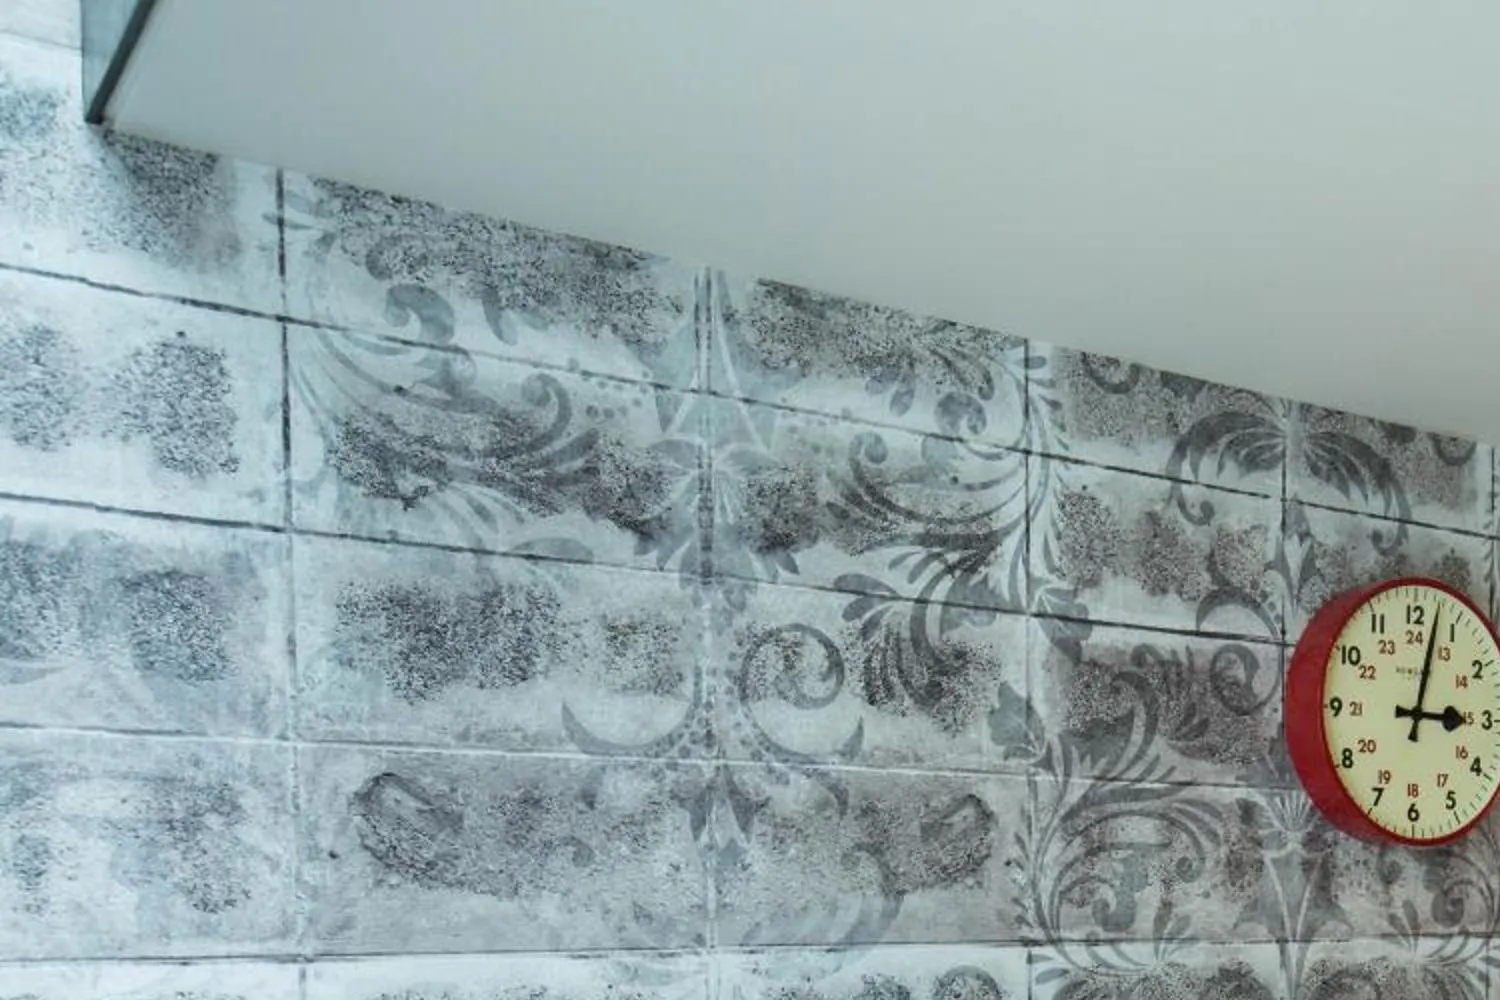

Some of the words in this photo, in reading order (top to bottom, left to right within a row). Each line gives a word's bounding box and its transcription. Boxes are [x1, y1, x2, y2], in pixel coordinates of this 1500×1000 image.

[1406, 604, 1424, 625] 12
[1371, 614, 1385, 634] 11
[1406, 631, 1424, 645] 24
[1341, 645, 1360, 665] 10
[1378, 640, 1395, 655] 23
[1437, 647, 1450, 661] 13
[1358, 666, 1376, 680] 22
[1472, 660, 1483, 679] 2
[1455, 675, 1468, 688] 14
[1329, 697, 1342, 717] 9
[1350, 702, 1362, 716] 21
[1481, 710, 1493, 730] 3
[1358, 739, 1376, 753] 20
[1455, 745, 1469, 759] 16
[1341, 748, 1353, 769] 8
[1470, 757, 1482, 776] 4
[1378, 770, 1392, 785] 19
[1437, 773, 1449, 788] 17
[1372, 787, 1384, 806] 7
[1407, 784, 1419, 797] 18
[1446, 790, 1457, 809] 5
[1408, 804, 1420, 822] 6
